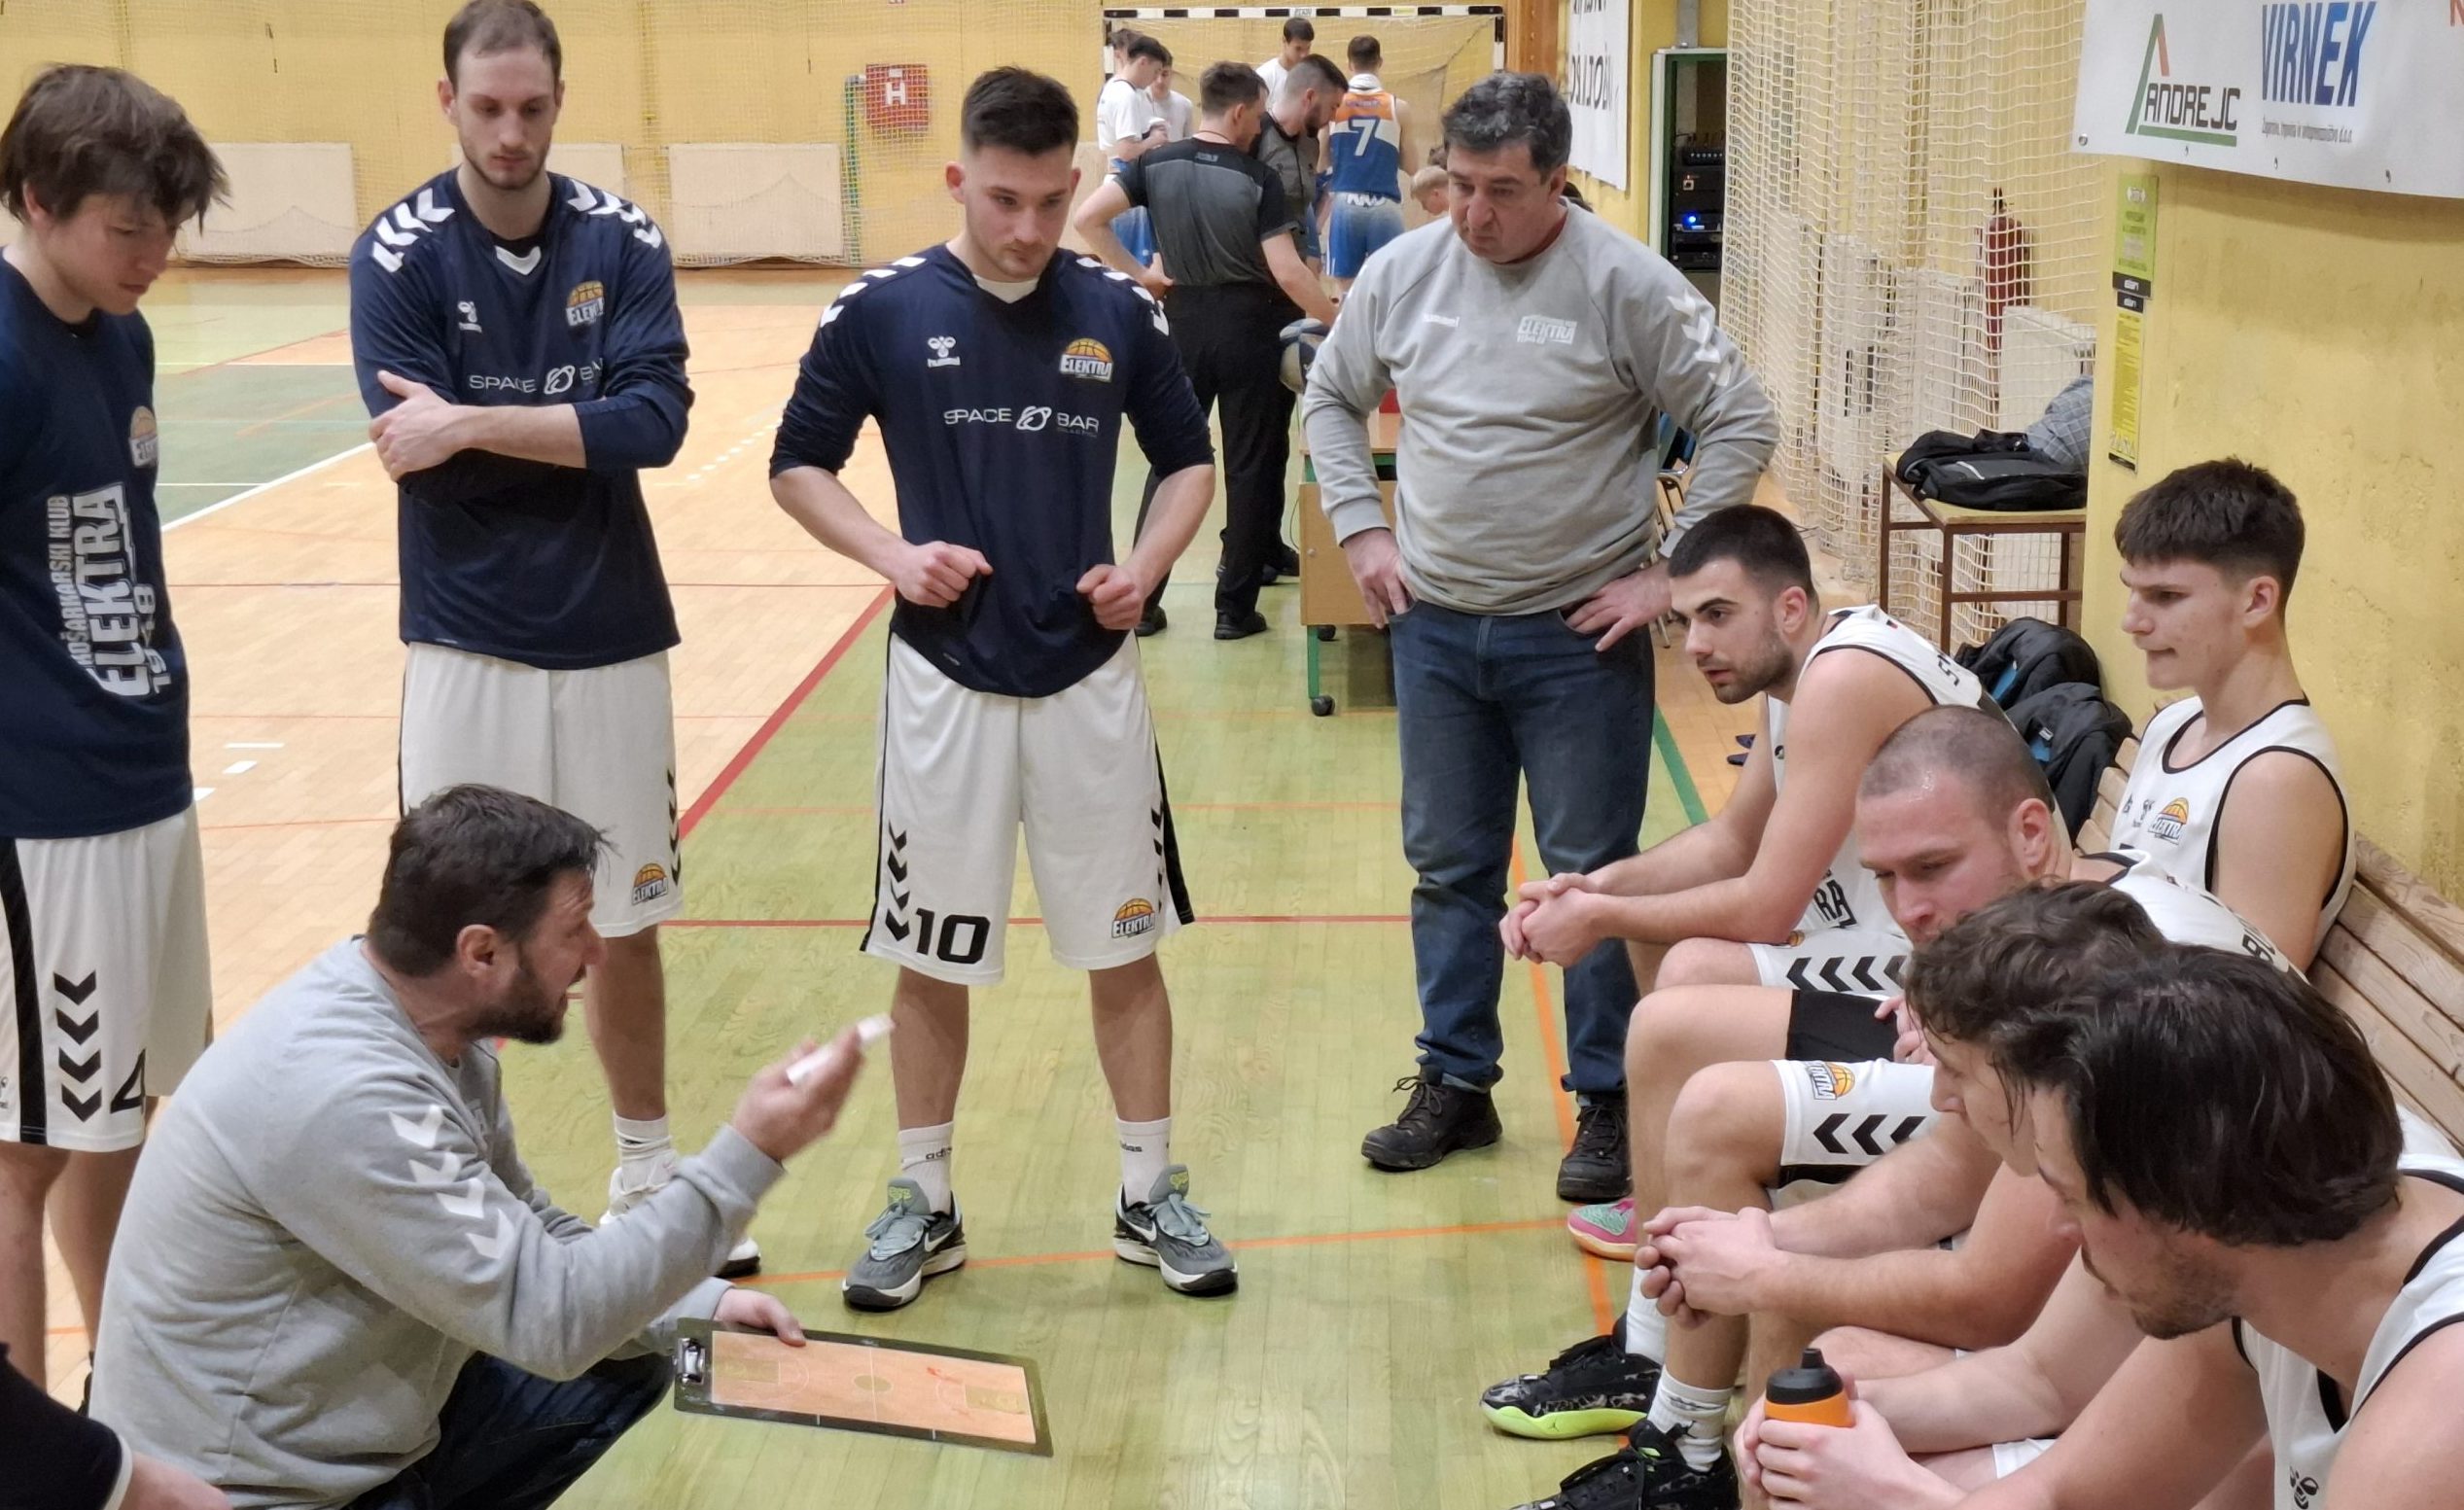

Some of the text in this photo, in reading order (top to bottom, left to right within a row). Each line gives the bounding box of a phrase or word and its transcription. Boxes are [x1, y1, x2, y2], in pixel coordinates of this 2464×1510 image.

[2261, 1, 2376, 107] VIRNEK
[886, 82, 905, 105] H
[2143, 82, 2240, 131] ANDREJC
[1349, 116, 1380, 158] 7
[1060, 354, 1112, 382] ELEKTRA
[944, 408, 1012, 425] SPACE
[1057, 412, 1100, 433] BAR
[48, 495, 72, 538] KLUB
[72, 481, 151, 696] ELEKTRA
[916, 888, 991, 965] 10
[110, 1048, 147, 1114] 4
